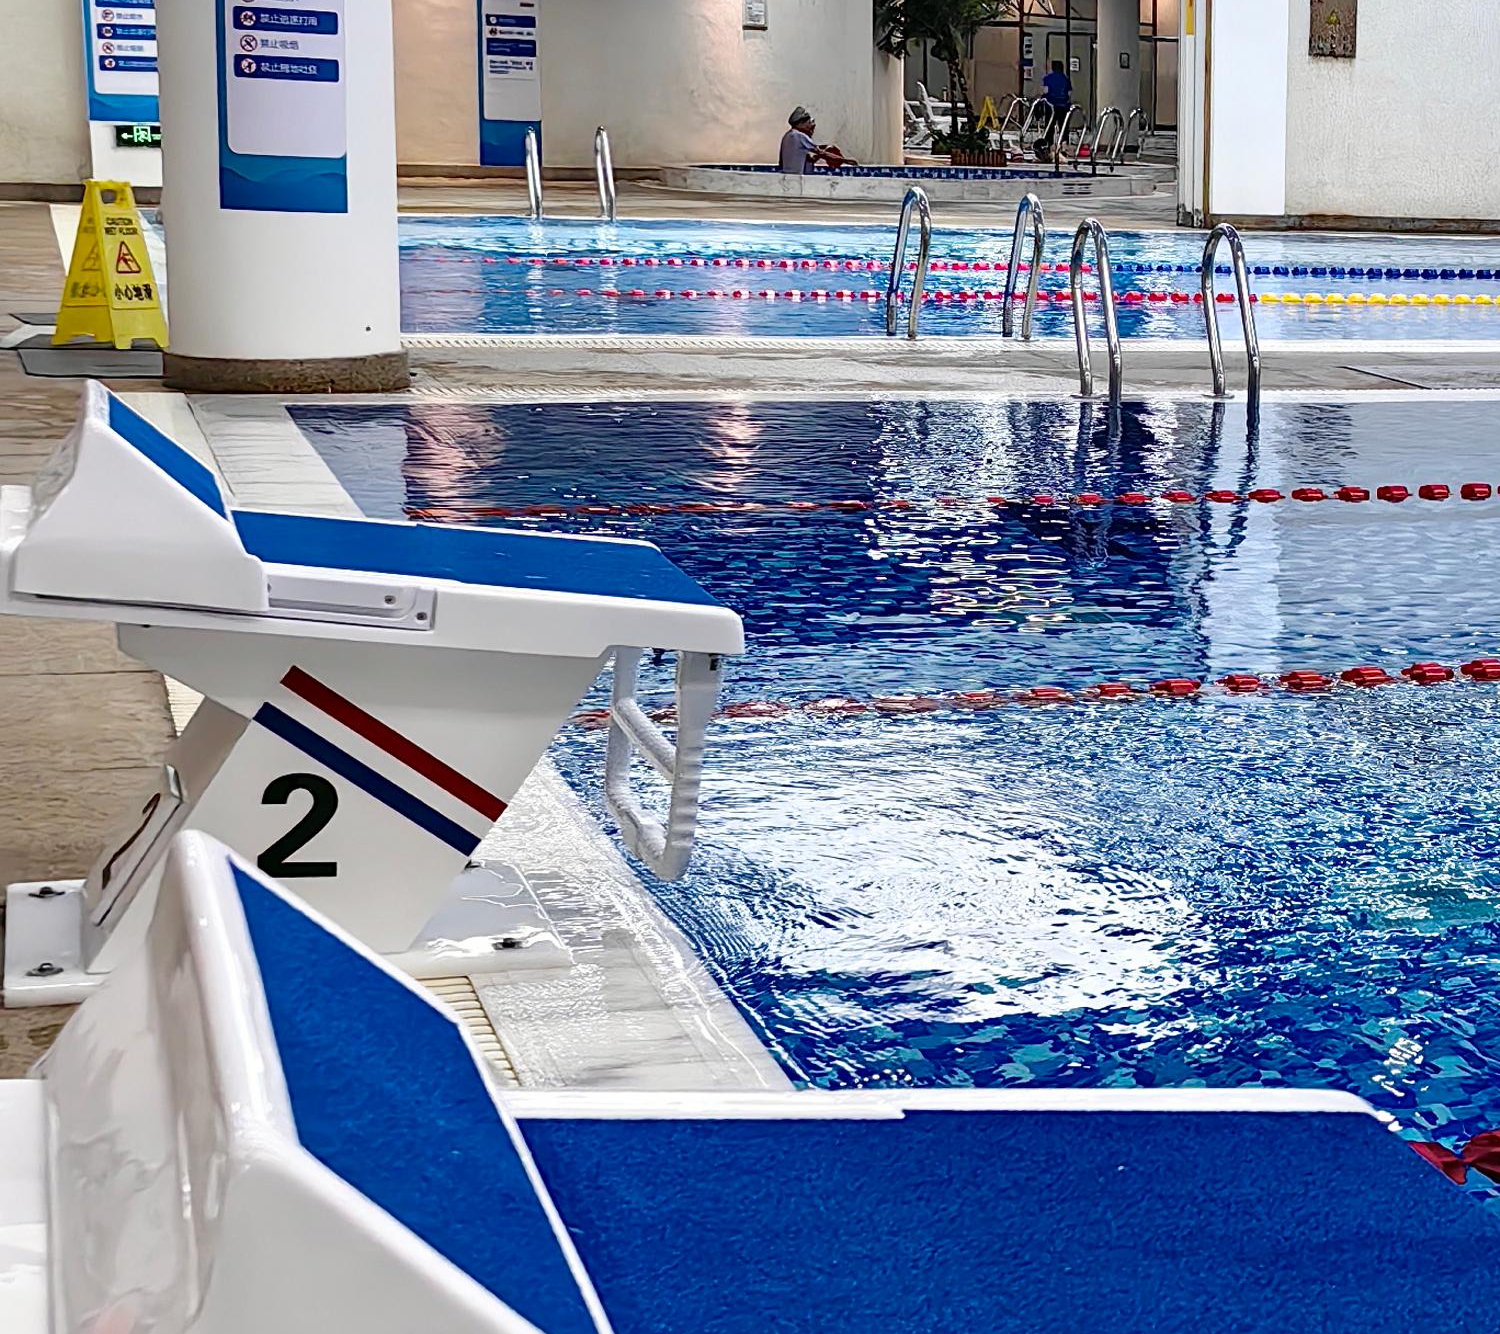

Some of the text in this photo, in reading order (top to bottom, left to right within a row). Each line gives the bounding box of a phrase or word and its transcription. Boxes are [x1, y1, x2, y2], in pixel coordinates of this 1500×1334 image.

[114, 283, 153, 301] 小心地滑
[257, 773, 338, 878] 2
